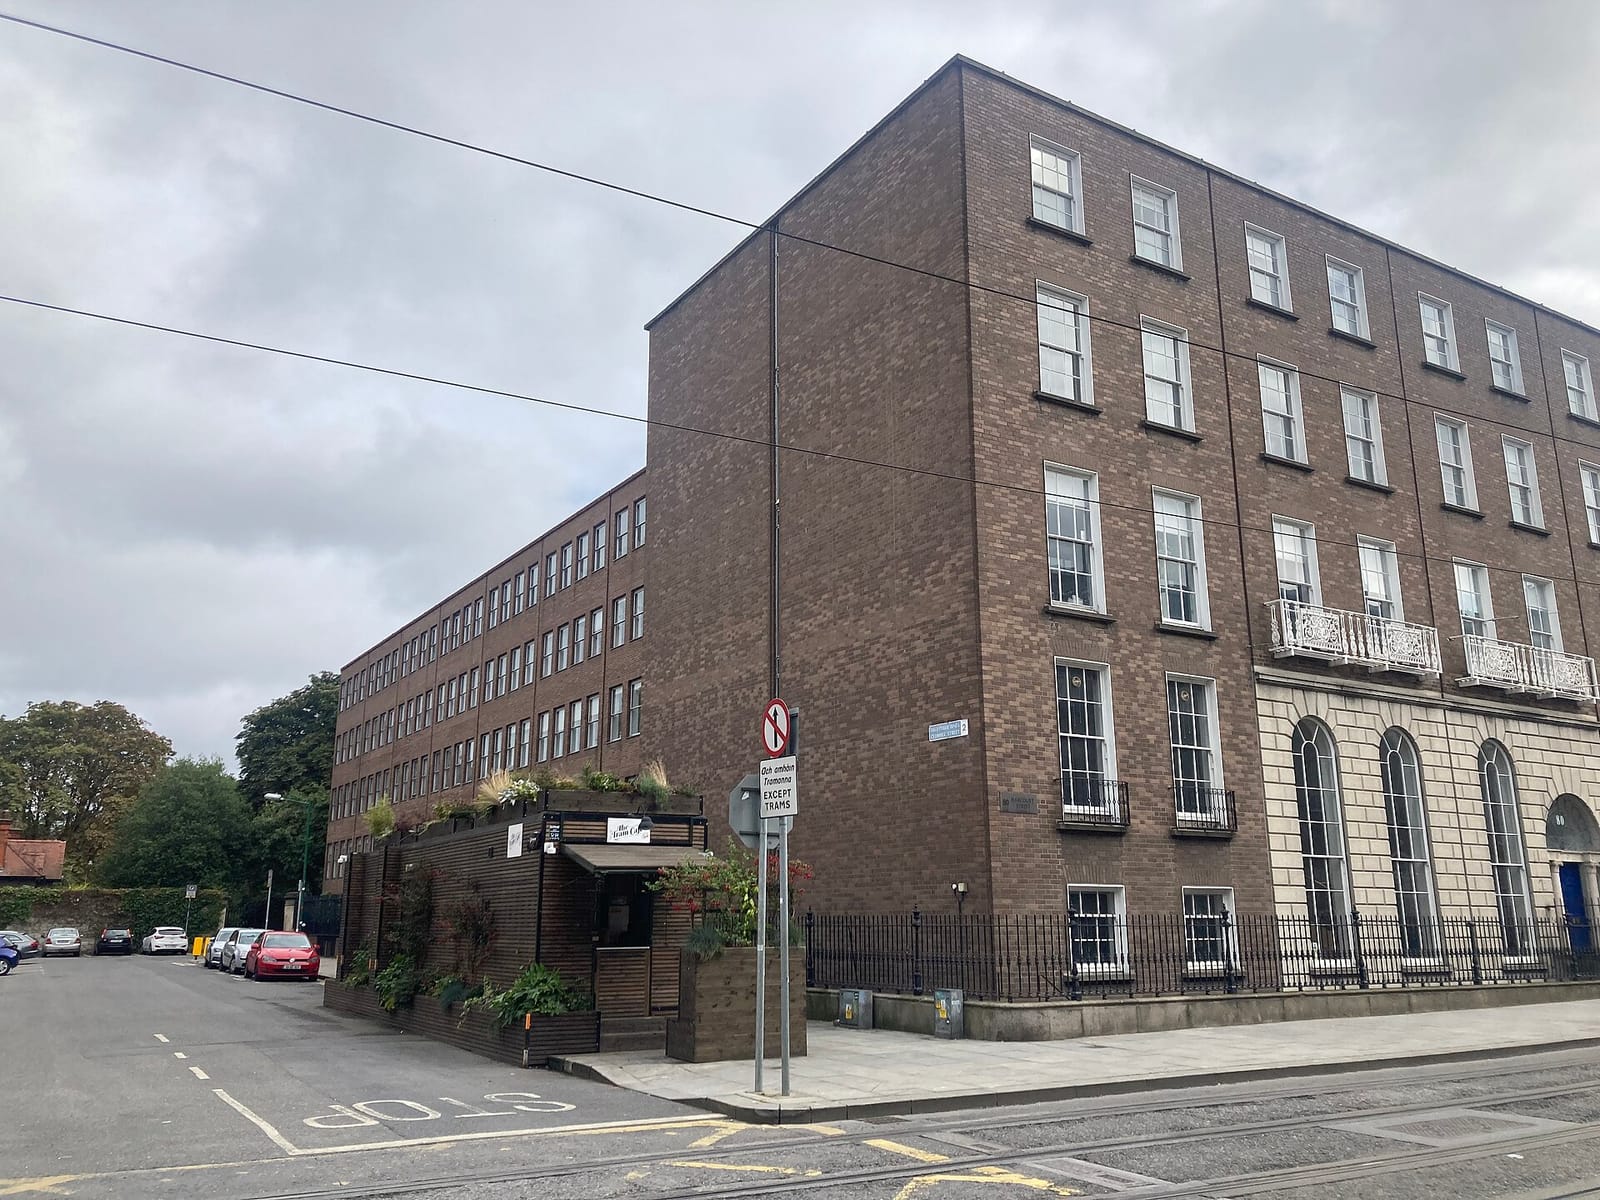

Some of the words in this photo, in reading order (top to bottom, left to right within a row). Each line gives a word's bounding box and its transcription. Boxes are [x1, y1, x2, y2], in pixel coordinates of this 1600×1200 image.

[763, 776, 792, 786] Tramanna
[763, 788, 791, 800] EXCEPT
[764, 800, 791, 811] TRAMS
[611, 830, 629, 838] Tram
[302, 1092, 577, 1130] STOP
